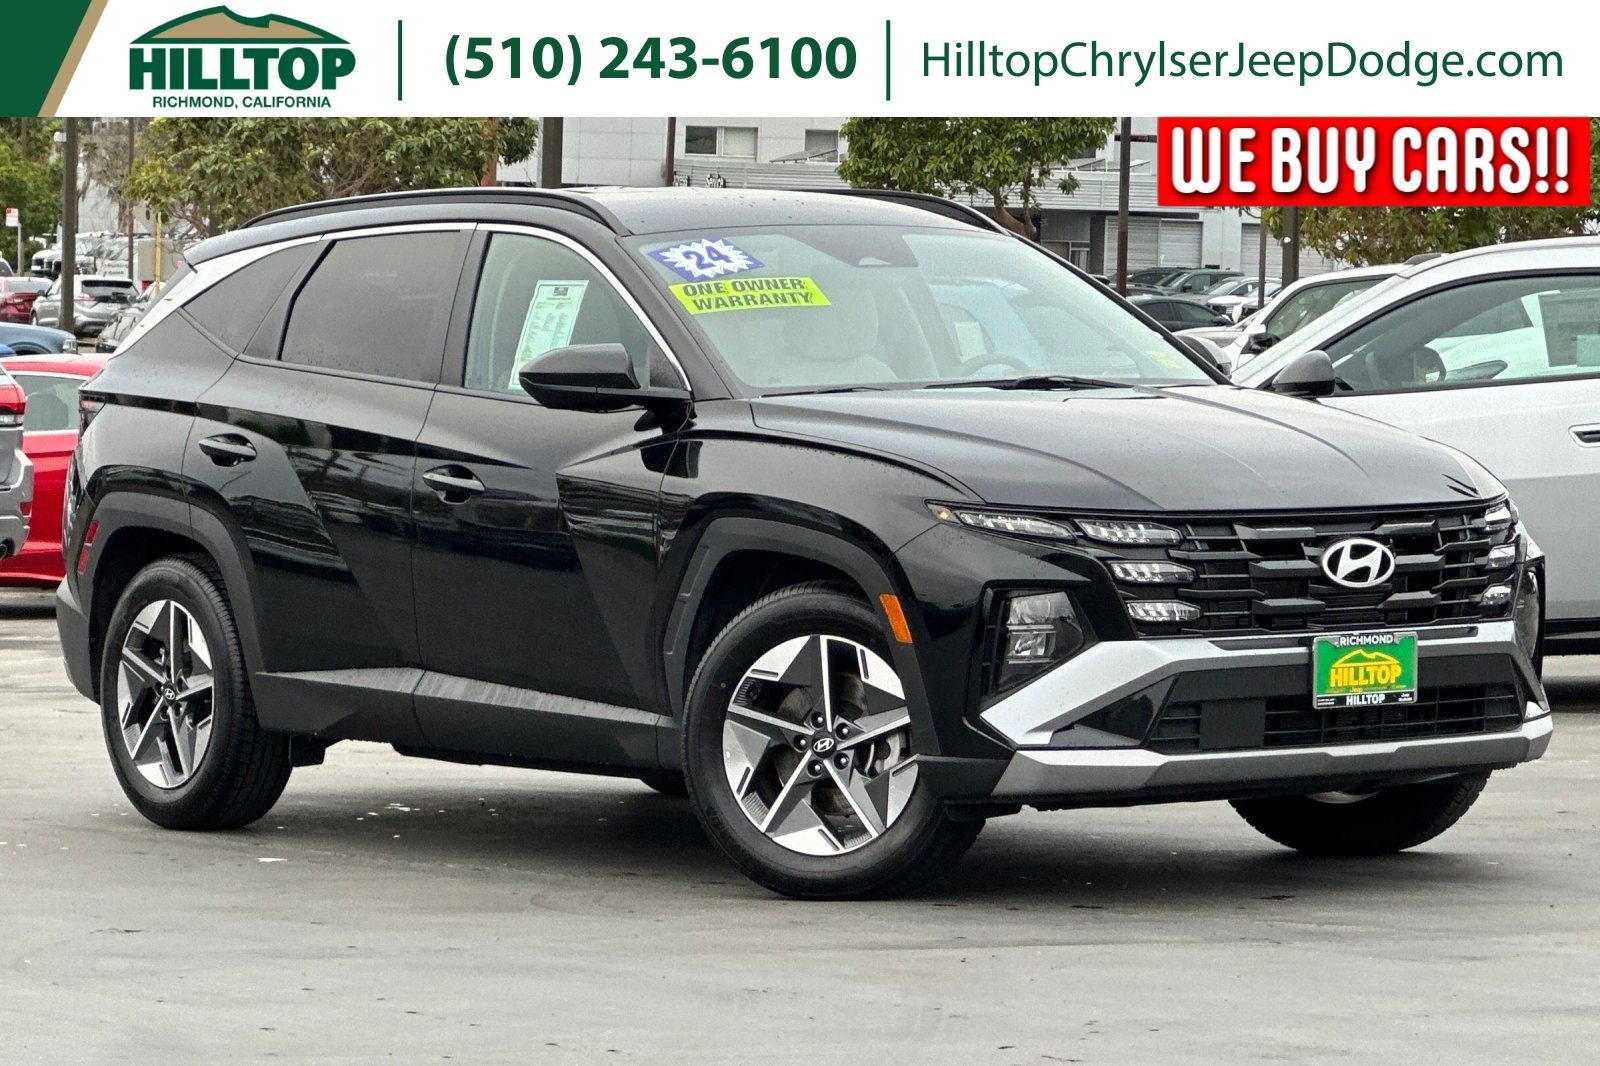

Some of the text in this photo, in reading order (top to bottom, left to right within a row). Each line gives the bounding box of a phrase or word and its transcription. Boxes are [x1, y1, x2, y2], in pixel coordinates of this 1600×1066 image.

[682, 245, 733, 270] 24
[683, 278, 805, 297] ONE OWNER
[693, 292, 812, 310] WARRANTY
[1340, 635, 1393, 646] RICHMOND
[1330, 665, 1402, 687] HILLTOP
[1346, 694, 1386, 706] HILLTOP
